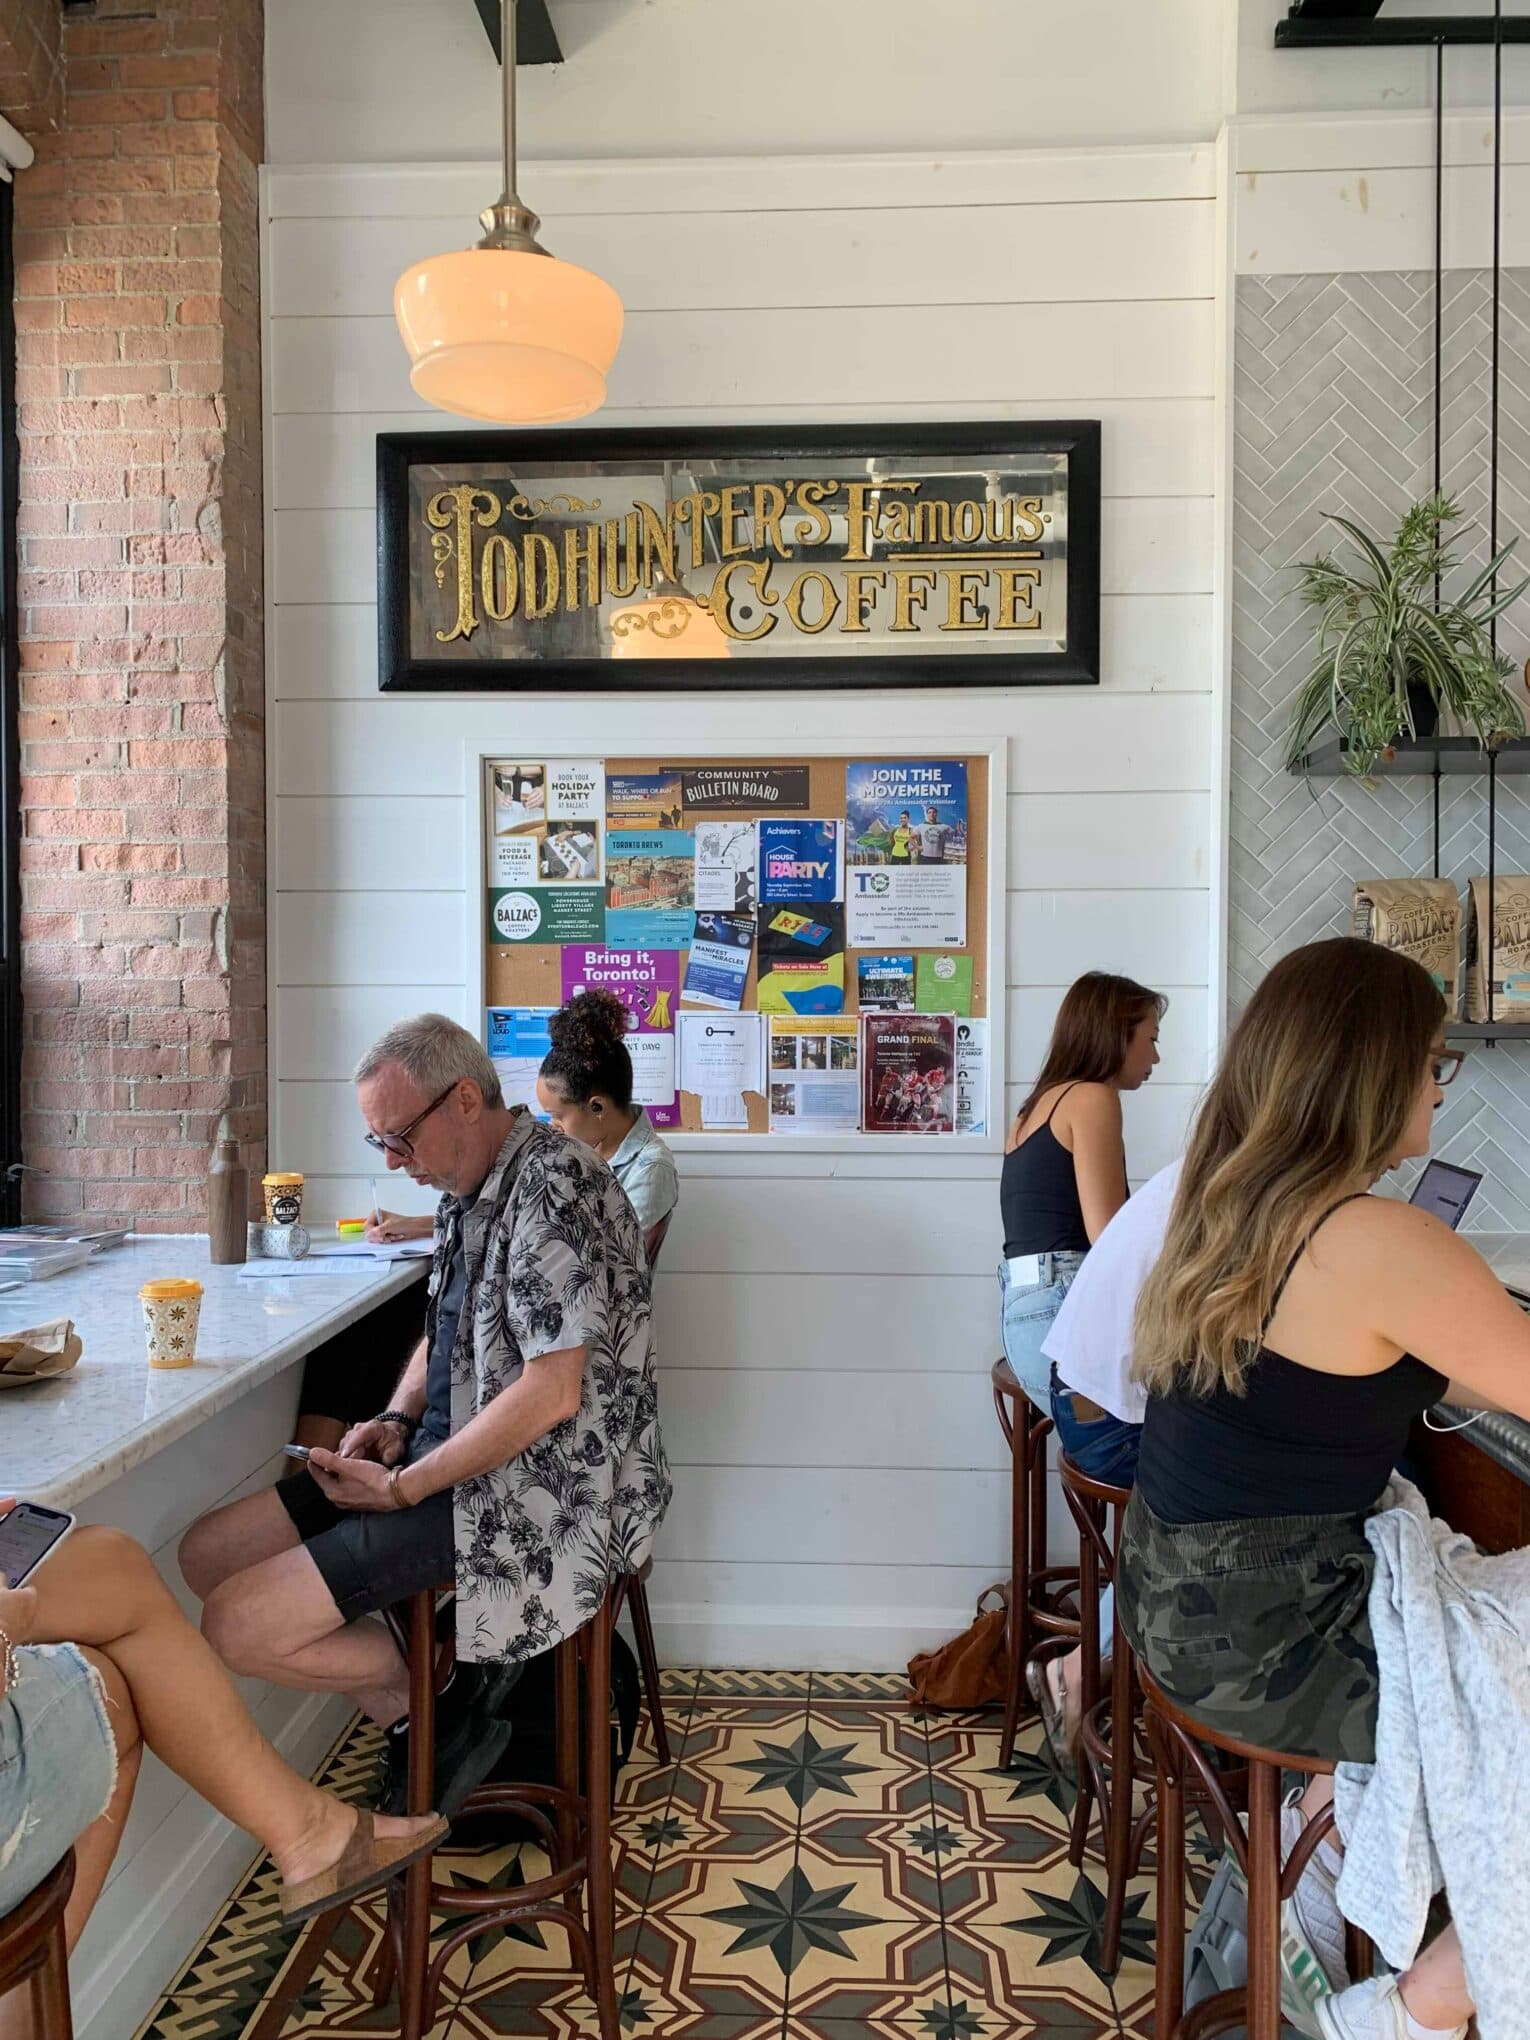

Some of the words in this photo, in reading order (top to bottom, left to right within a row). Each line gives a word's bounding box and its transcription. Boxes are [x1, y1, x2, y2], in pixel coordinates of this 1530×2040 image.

[427, 480, 838, 642] TODHUNTER'S
[697, 557, 1042, 641] COFFEE
[697, 771, 770, 779] COMMUNITY
[872, 769, 907, 782] JOIN
[910, 769, 942, 781] THE
[558, 792, 590, 800] PARTY
[686, 781, 740, 802] BULLETIN
[742, 781, 779, 801] BOARD
[864, 784, 952, 798] MOVEMENT
[766, 827, 801, 835] Achievers
[612, 841, 640, 849] TORONTO
[641, 841, 663, 849] BREWS
[769, 861, 830, 879] PARTY
[1403, 906, 1434, 920] COFFEE
[1506, 912, 1530, 923] COFF
[695, 945, 728, 956] MANIFEST
[1404, 935, 1447, 953] ROASTERS
[1507, 945, 1530, 955] ROAS
[584, 951, 631, 967] Bring
[637, 950, 654, 966] it,
[711, 954, 745, 965] MIRACLES
[583, 967, 656, 981] Toronto!
[877, 1035, 910, 1044] GRAND
[911, 1035, 940, 1044] FINAL
